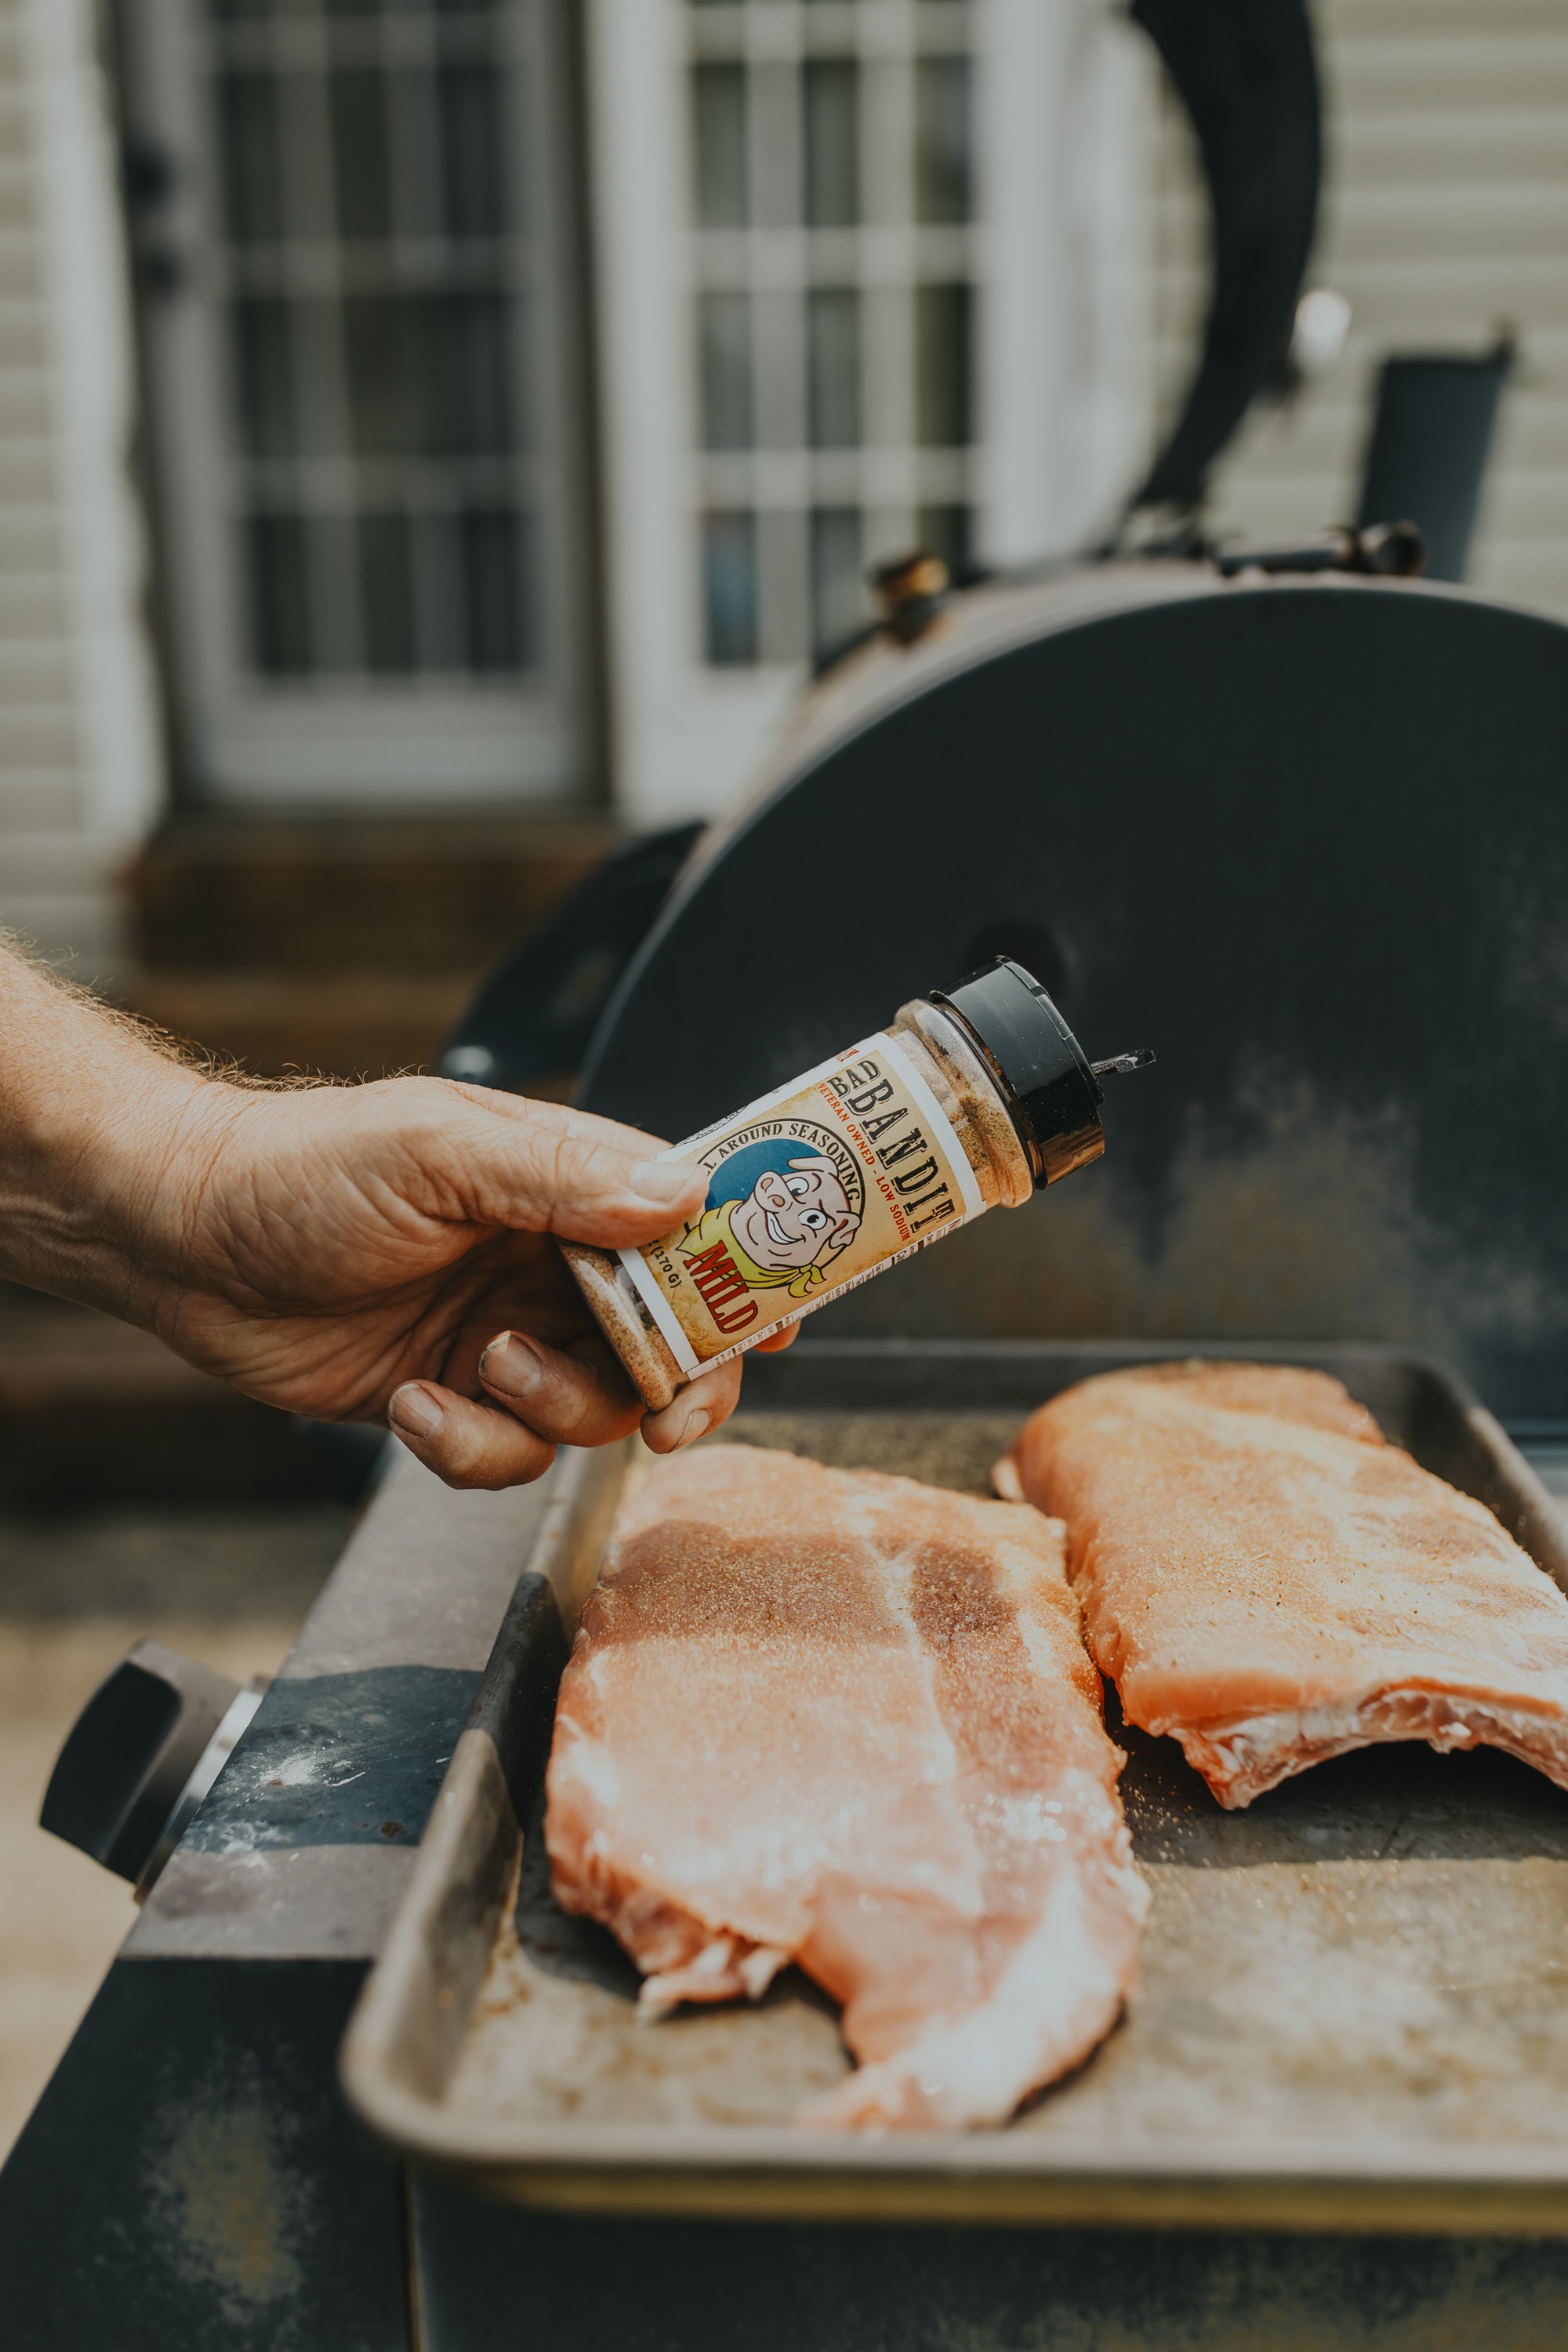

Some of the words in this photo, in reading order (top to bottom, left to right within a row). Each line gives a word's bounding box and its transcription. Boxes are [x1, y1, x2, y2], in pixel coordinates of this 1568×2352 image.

[827, 1060, 880, 1099] BAD
[718, 1123, 782, 1158] AROUND
[789, 1123, 860, 1201] SEASONING
[817, 1083, 850, 1122] VETERAN
[847, 1124, 875, 1165] OWNED
[876, 1176, 895, 1201] LOW
[890, 1204, 911, 1241] SODIUM
[844, 1079, 956, 1234] BANDIT
[651, 1247, 673, 1272] (170
[668, 1273, 682, 1288] G)
[683, 1240, 758, 1334] MILD
